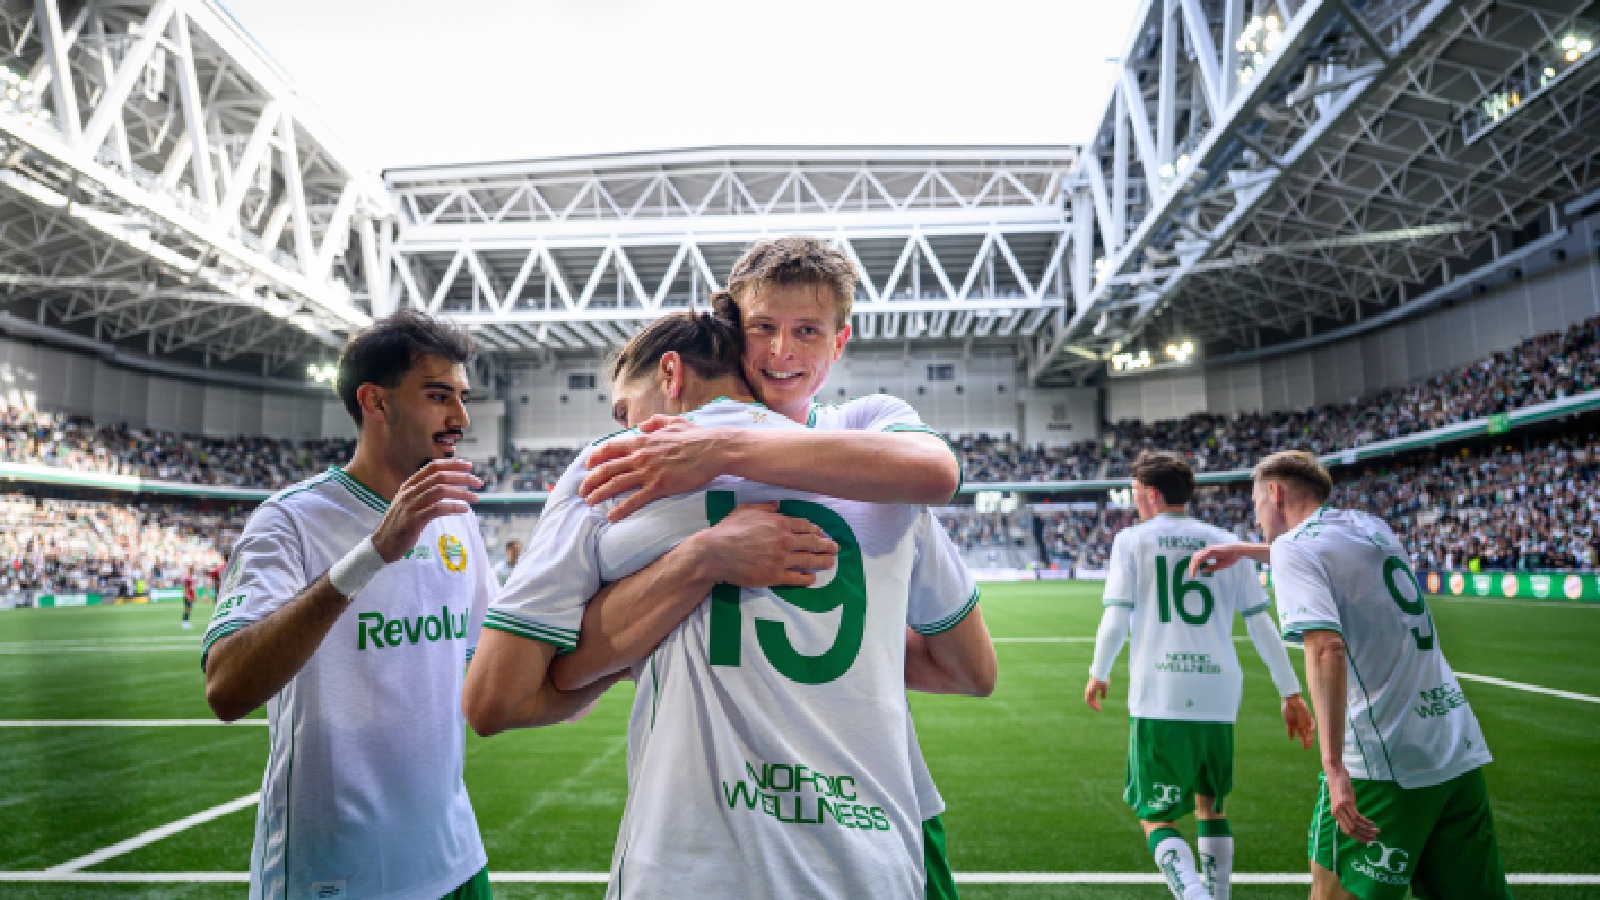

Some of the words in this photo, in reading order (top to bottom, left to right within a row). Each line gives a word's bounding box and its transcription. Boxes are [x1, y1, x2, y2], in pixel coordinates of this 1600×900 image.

[706, 490, 867, 685] 19
[1155, 555, 1214, 625] 16
[1383, 555, 1434, 650] 9
[723, 779, 891, 831] WELLNESS
[745, 760, 857, 801] NORDIC
